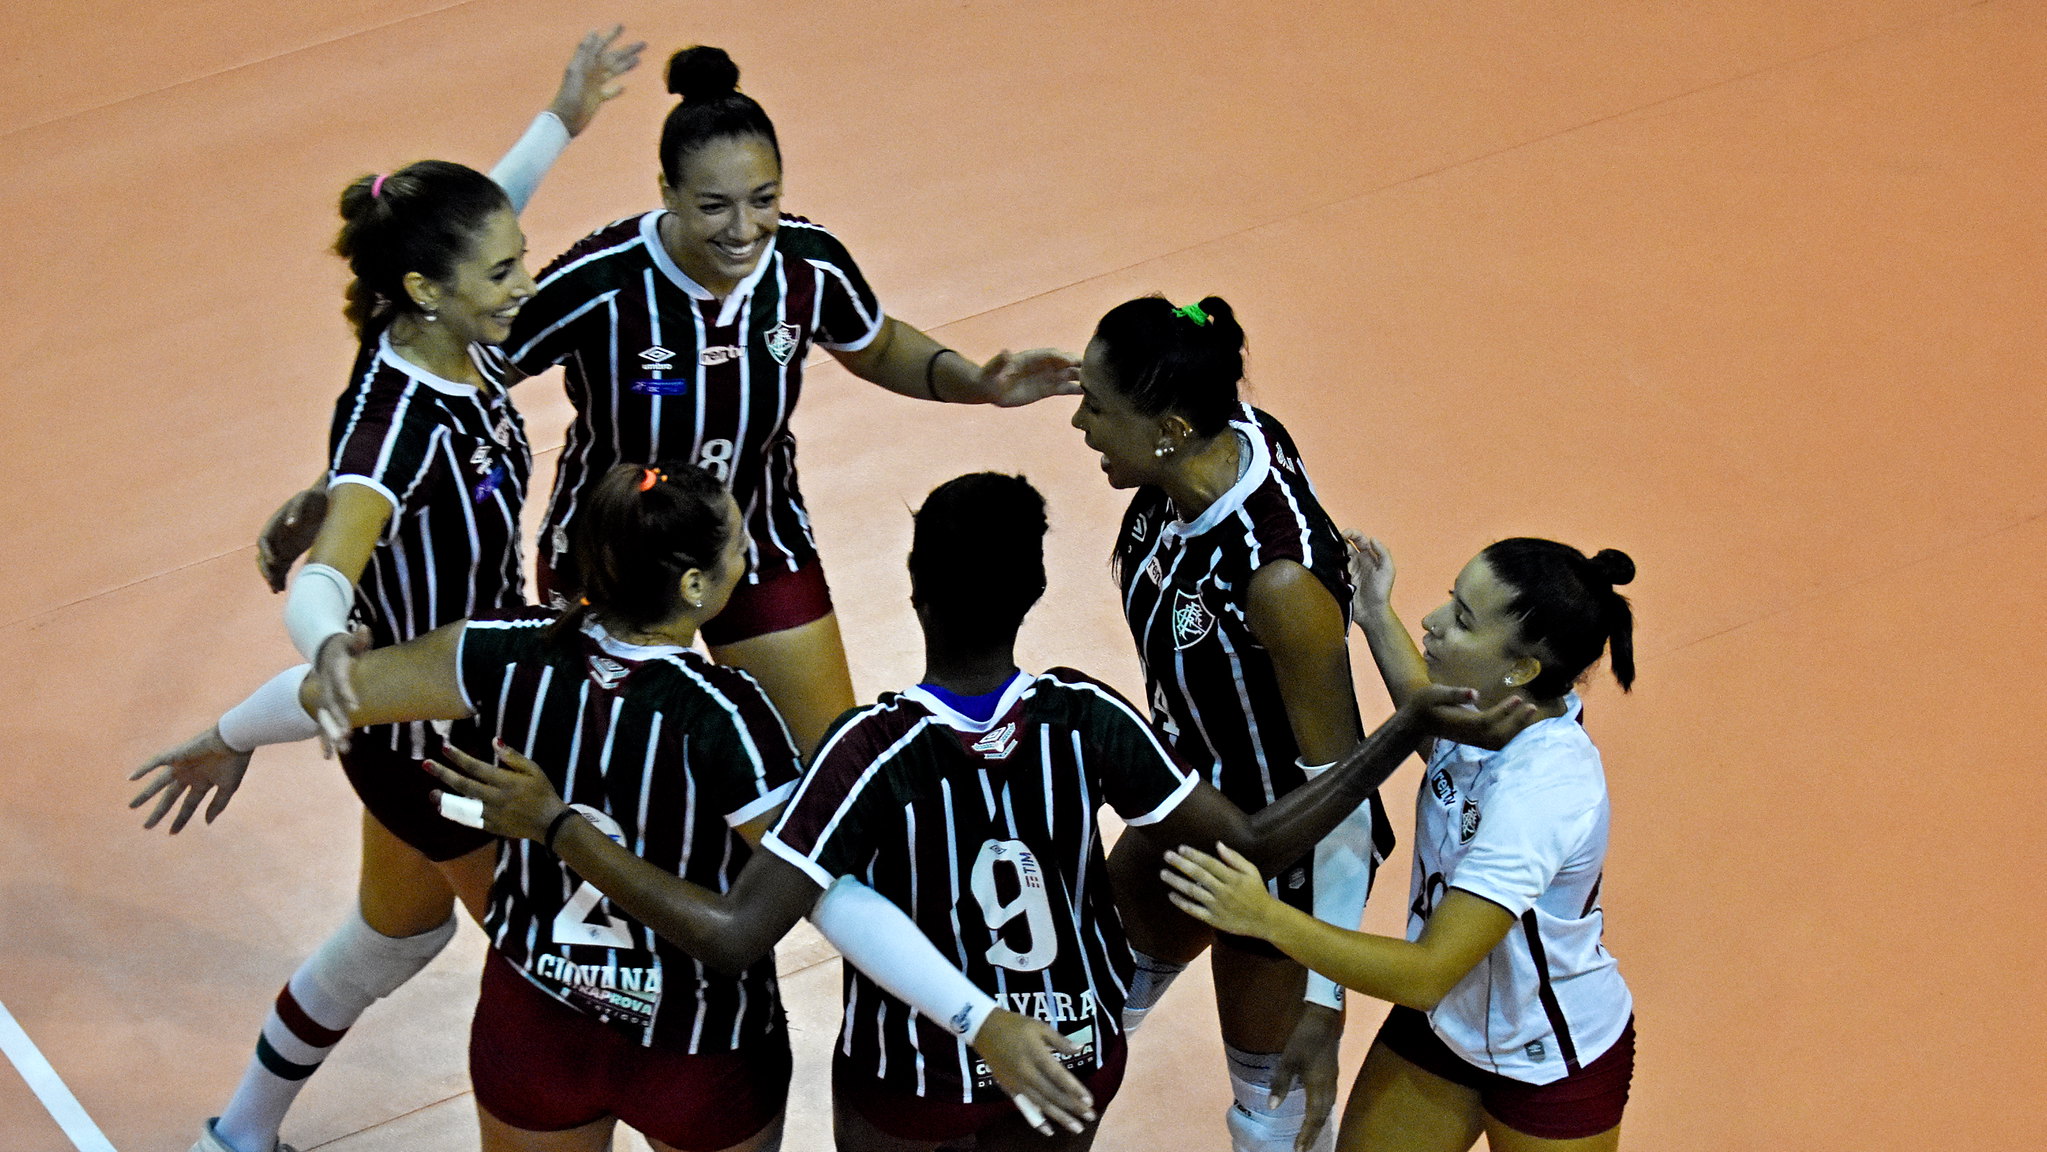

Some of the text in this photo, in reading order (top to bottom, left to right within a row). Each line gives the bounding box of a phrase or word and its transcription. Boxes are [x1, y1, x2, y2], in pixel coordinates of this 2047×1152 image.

[701, 438, 734, 482] 8
[1019, 851, 1037, 874] TIM
[970, 838, 1058, 972] 9
[994, 987, 1097, 1022] AYARA
